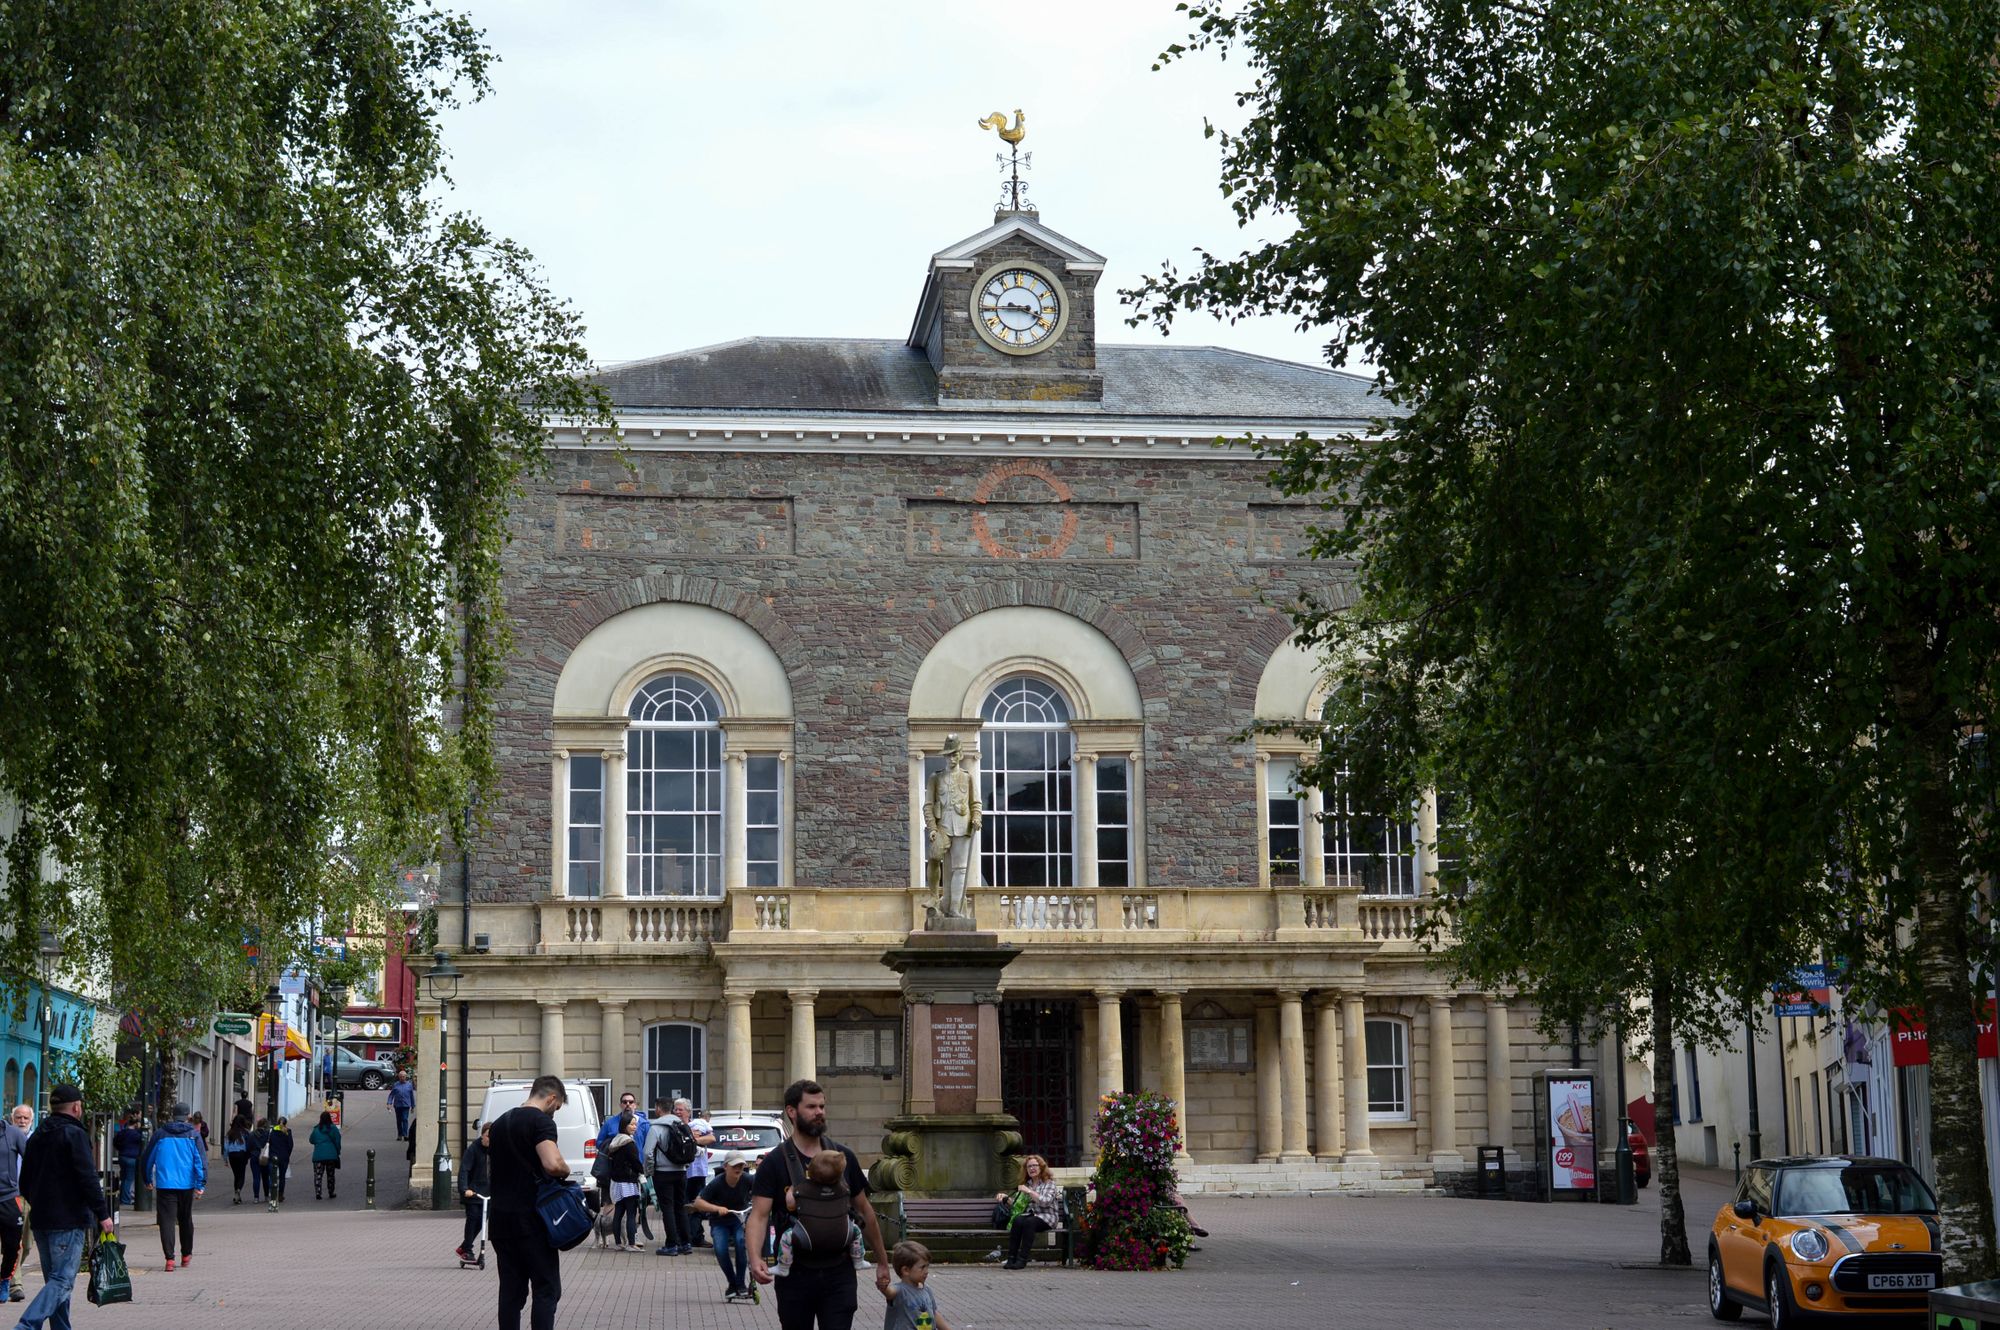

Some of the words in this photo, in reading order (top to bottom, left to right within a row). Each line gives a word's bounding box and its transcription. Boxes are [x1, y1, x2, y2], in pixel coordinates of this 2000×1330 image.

[1798, 979, 1825, 988] rkwrig
[1873, 1276, 1904, 1288] CP66
[1907, 1275, 1930, 1287] XBT
